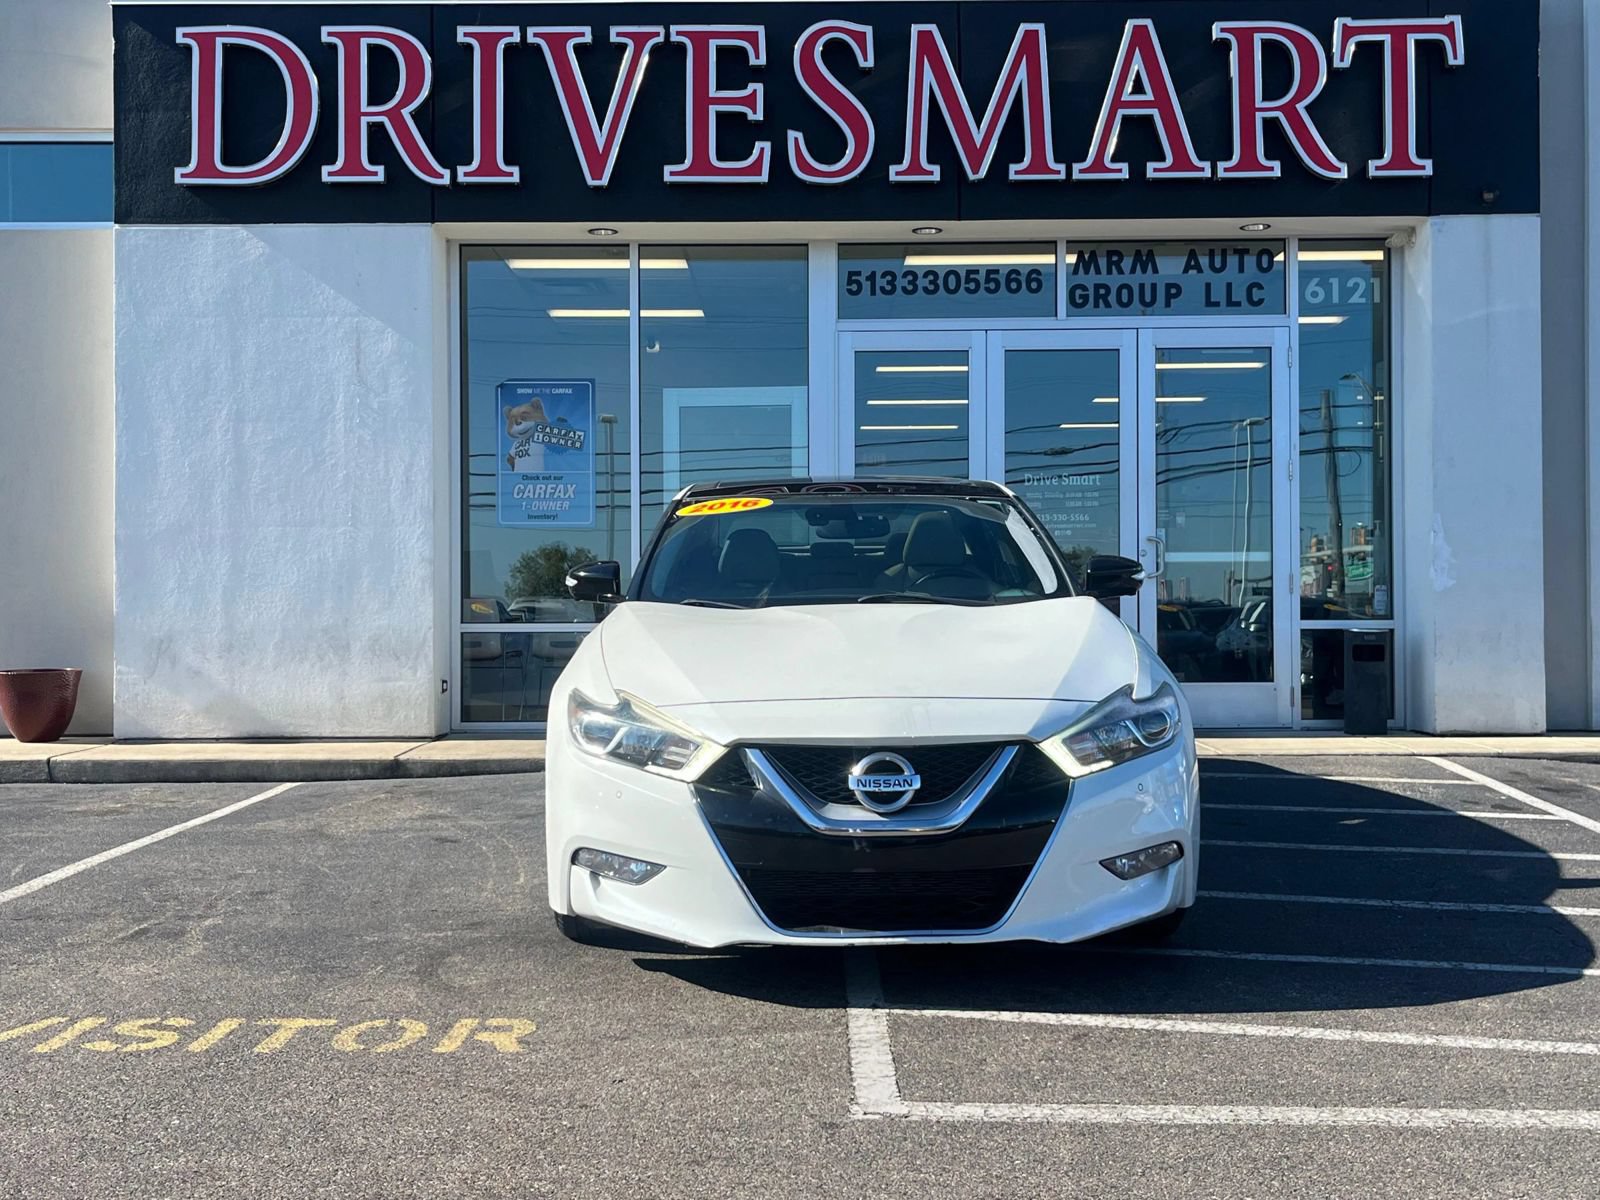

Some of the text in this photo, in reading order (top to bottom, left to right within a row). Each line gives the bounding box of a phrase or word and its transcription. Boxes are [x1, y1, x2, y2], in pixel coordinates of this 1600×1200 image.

[174, 15, 1465, 188] DRIVESMART
[1072, 248, 1275, 275] MRM AUTO
[846, 268, 1043, 296] 5133305566
[1068, 282, 1265, 309] GROUP LLC
[1305, 277, 1381, 304] 6121
[536, 424, 584, 442] CARFAX
[543, 436, 581, 449] OWNER
[514, 448, 531, 459] FOX
[1024, 473, 1101, 486] Drive Smart
[513, 484, 576, 499] CARFAX
[521, 500, 570, 511] 1-OWNER
[688, 500, 763, 514] 2016
[856, 778, 913, 788] NISSAN
